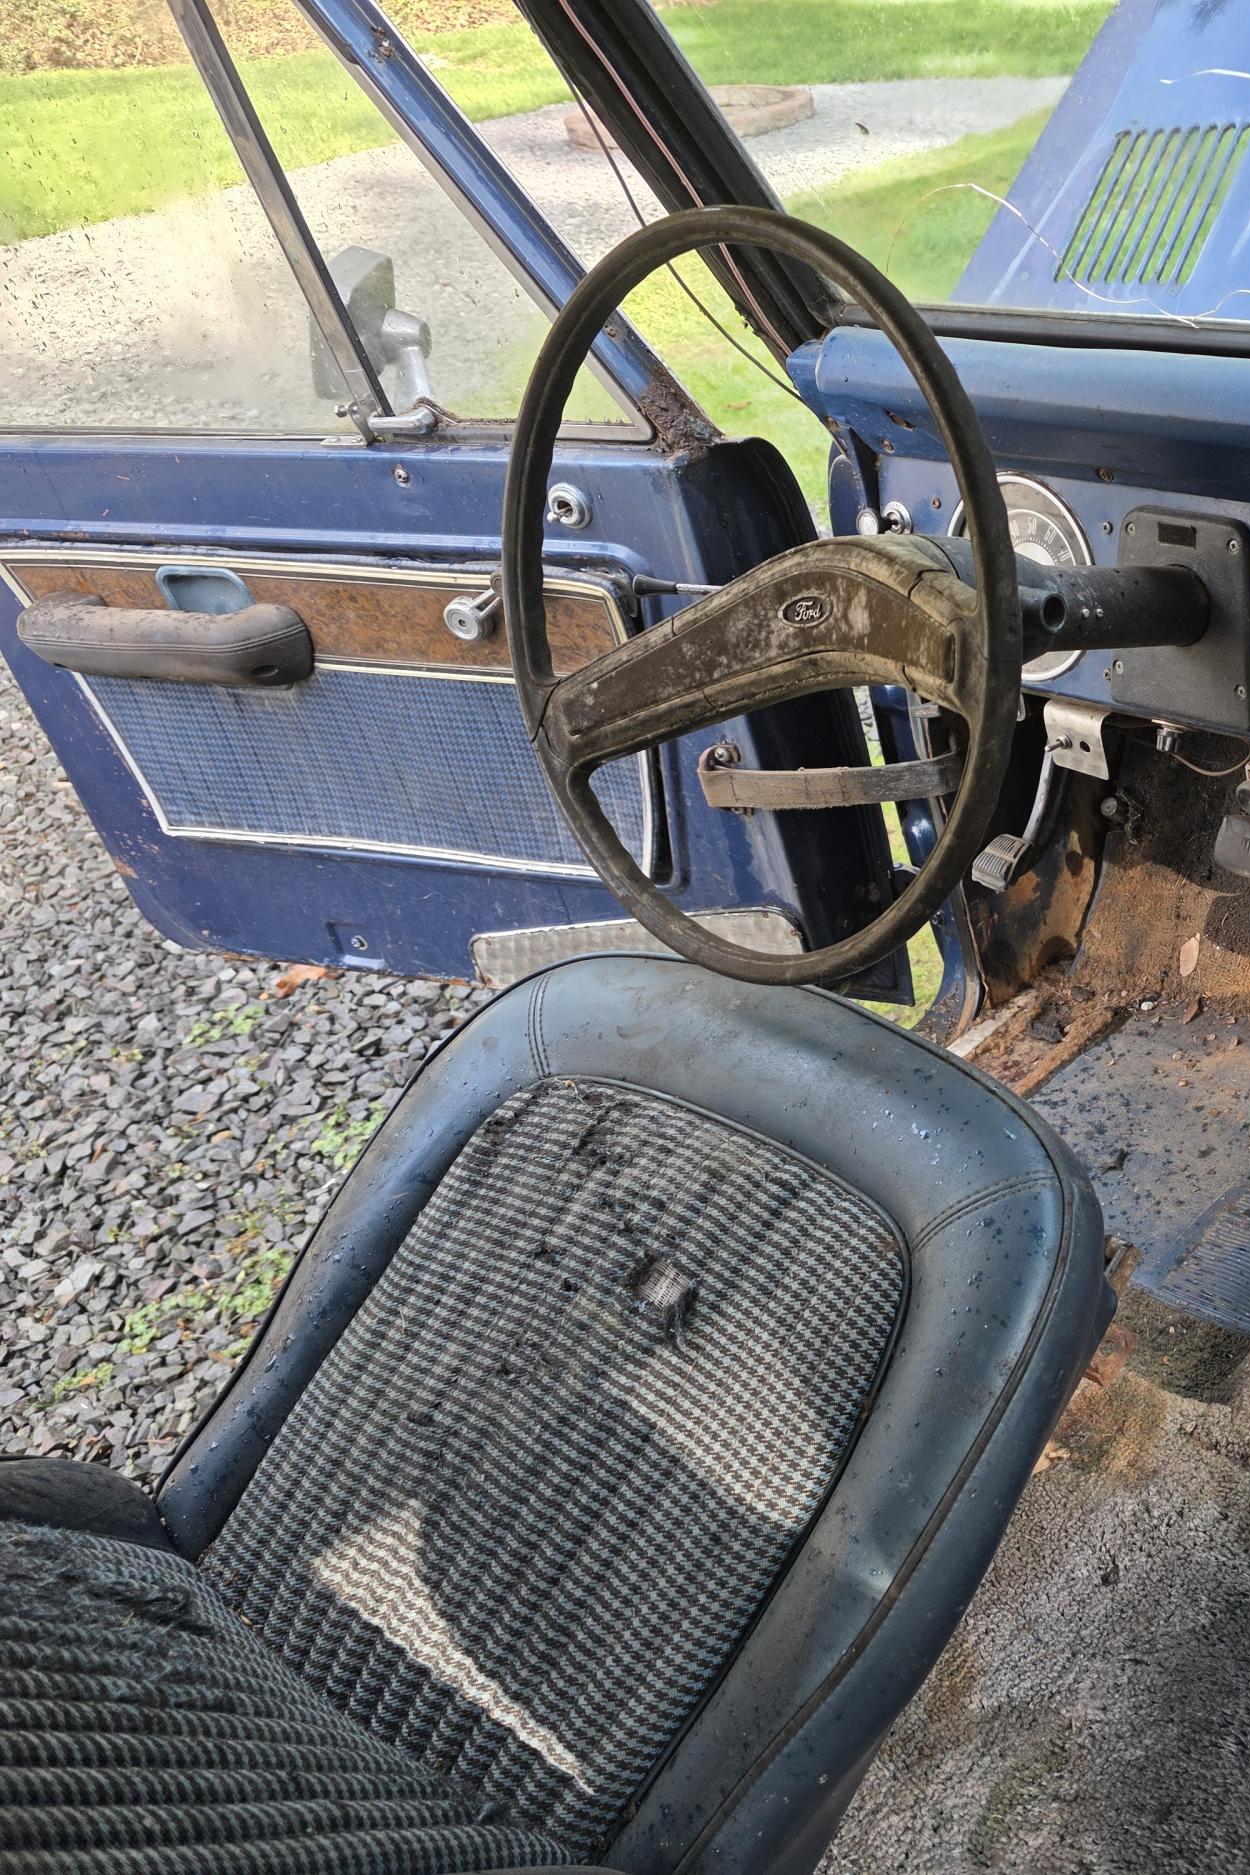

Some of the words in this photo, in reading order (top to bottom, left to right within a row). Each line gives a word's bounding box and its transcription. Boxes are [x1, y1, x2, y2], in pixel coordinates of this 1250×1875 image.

[1027, 517, 1037, 535] 50
[1043, 524, 1058, 544] 60
[794, 601, 822, 621] Ford
